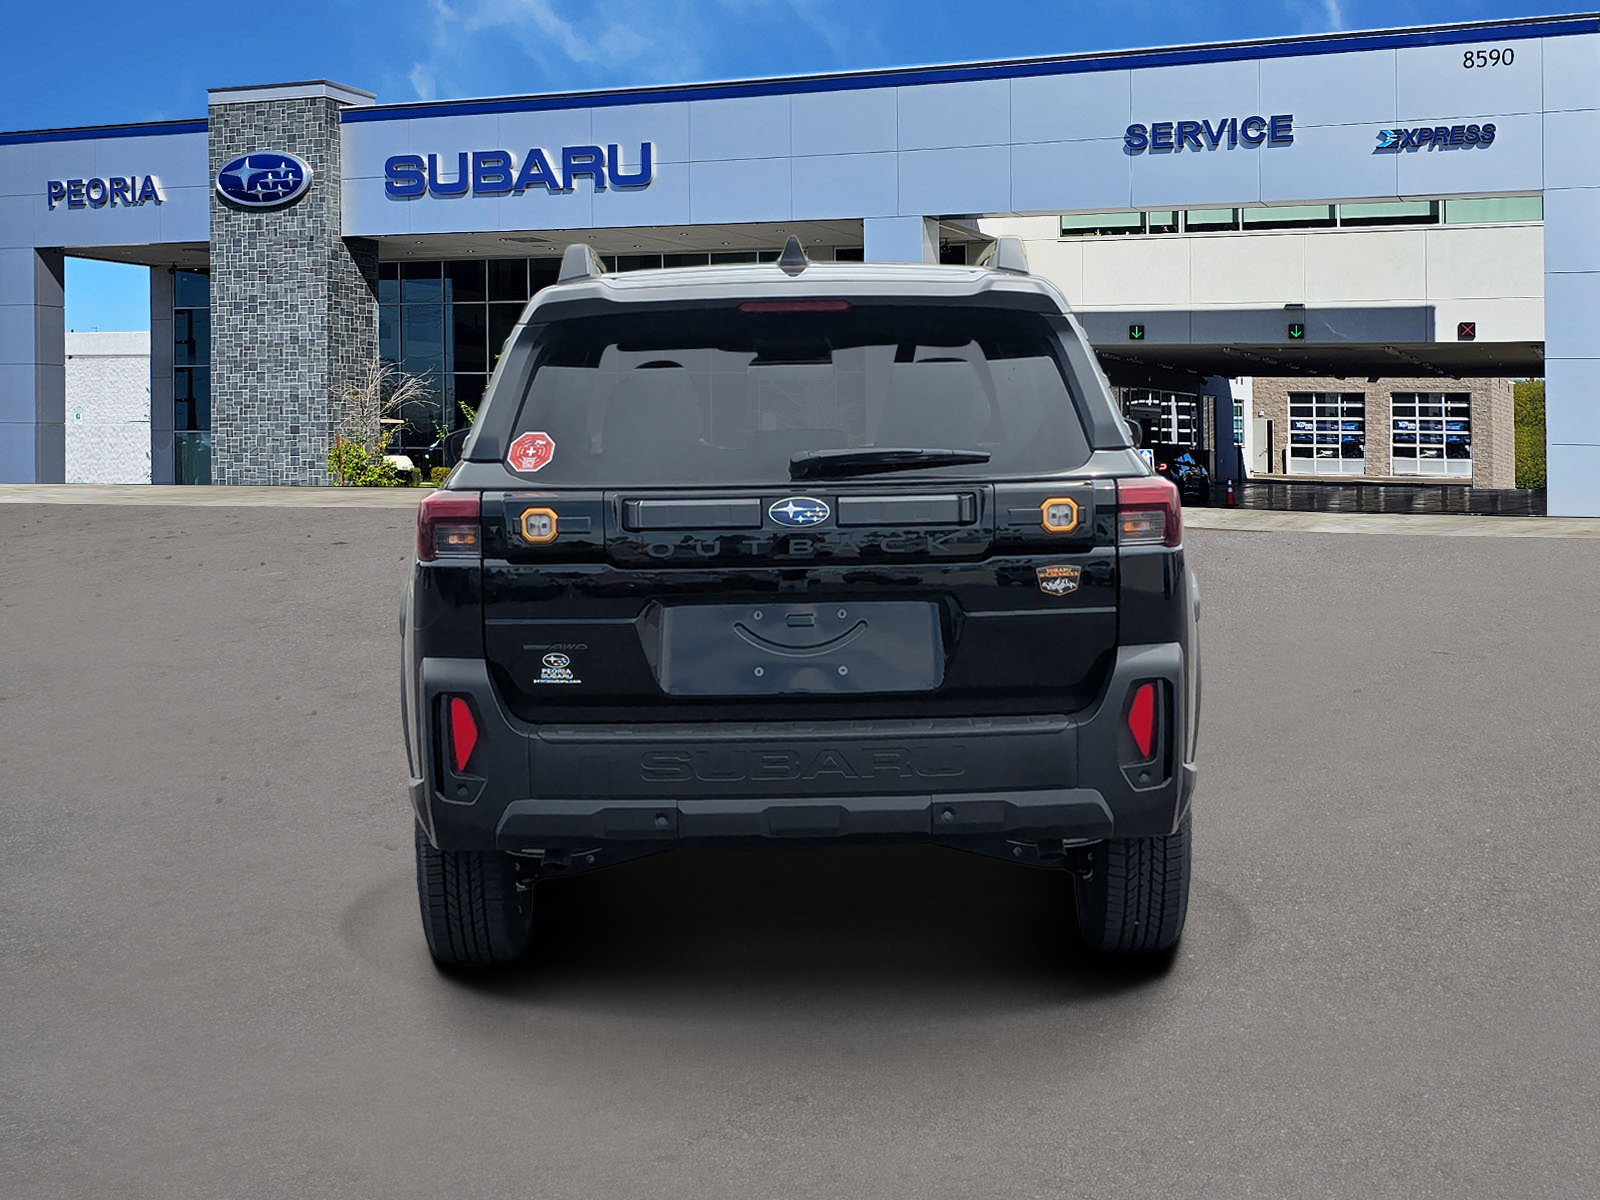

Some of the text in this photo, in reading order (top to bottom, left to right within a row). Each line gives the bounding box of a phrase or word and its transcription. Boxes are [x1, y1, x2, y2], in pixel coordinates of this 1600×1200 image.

[1463, 48, 1515, 69] 8590
[1125, 114, 1294, 151] SERVICE
[1376, 123, 1497, 148] EXPRESS
[384, 142, 652, 197] SUBARU
[47, 175, 162, 207] PEORIA
[645, 535, 953, 558] OUTBACK
[640, 748, 967, 782] SUBARU
